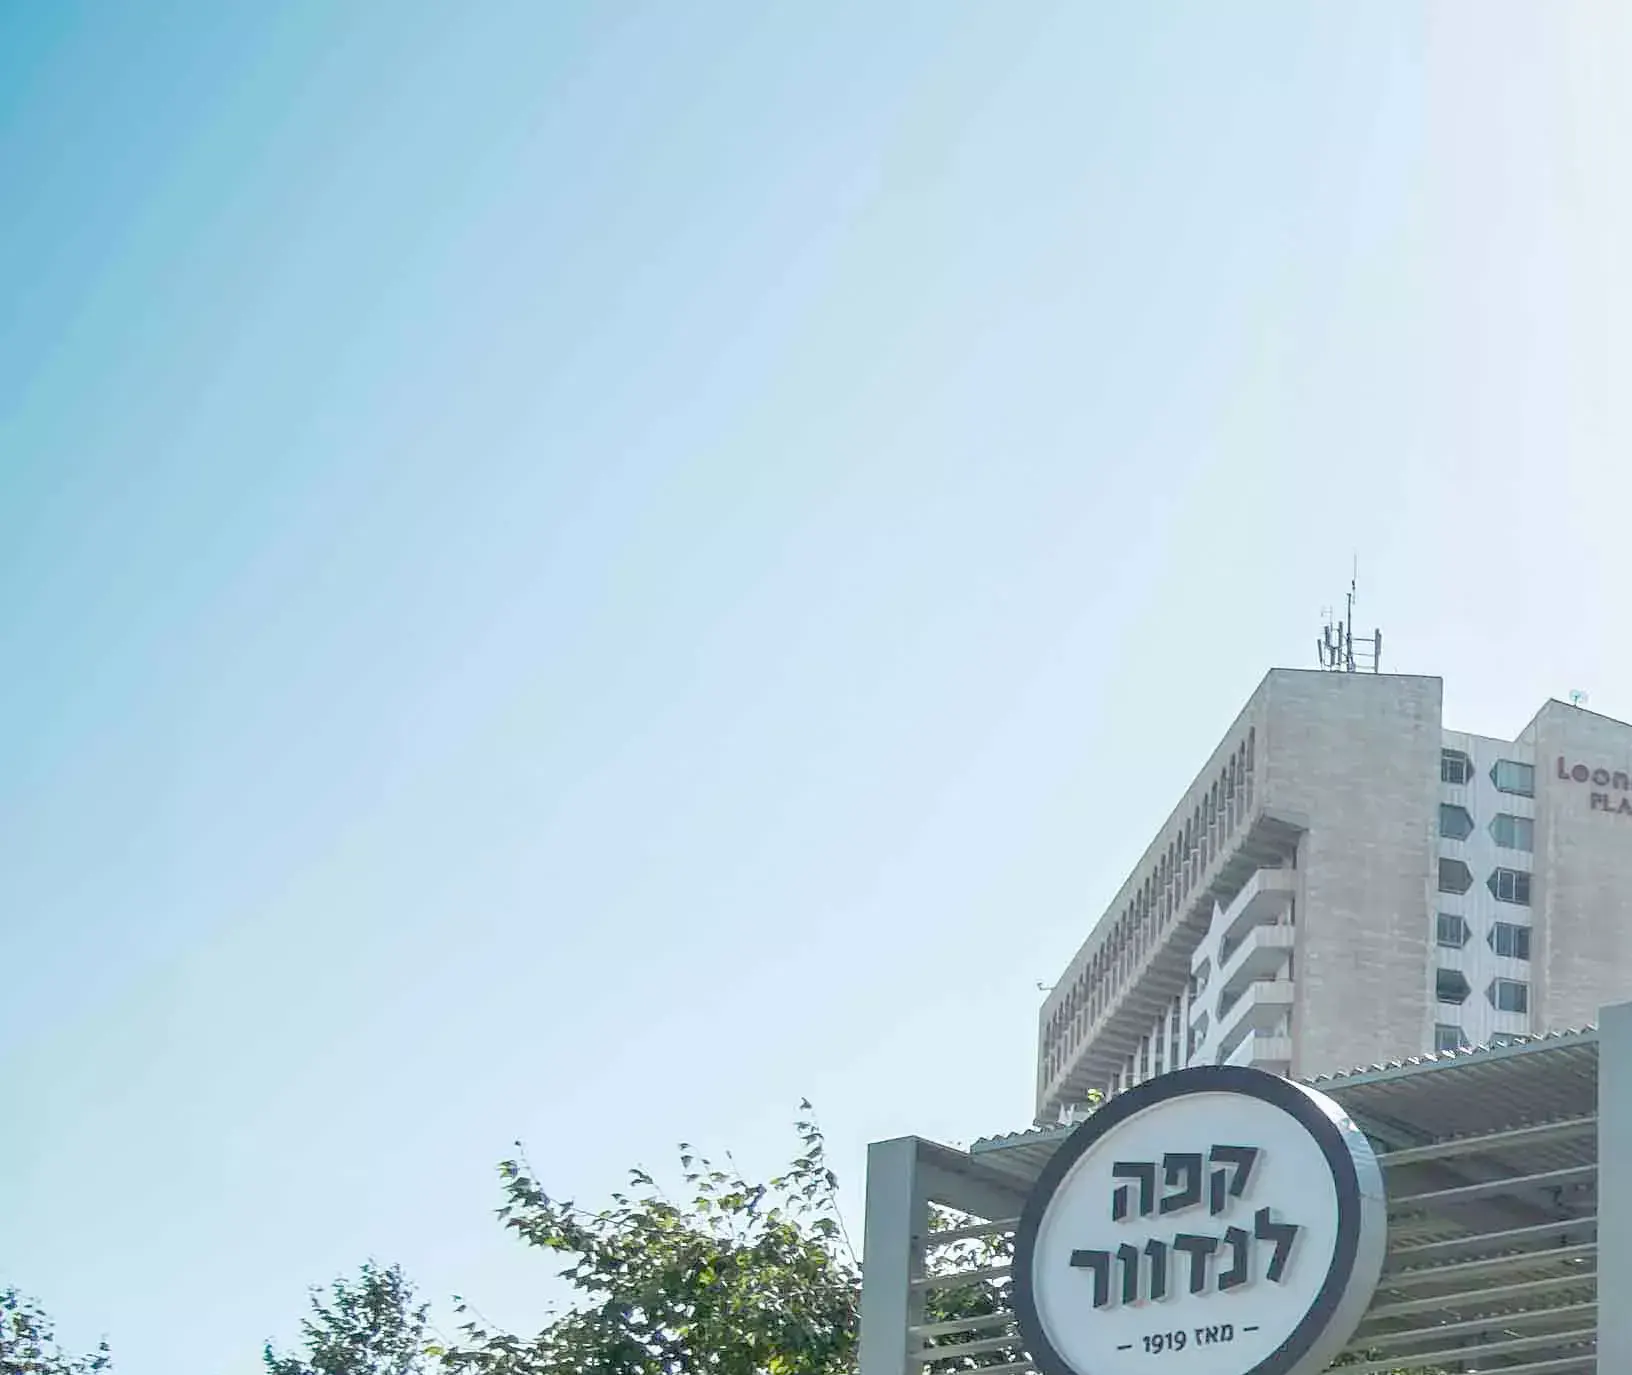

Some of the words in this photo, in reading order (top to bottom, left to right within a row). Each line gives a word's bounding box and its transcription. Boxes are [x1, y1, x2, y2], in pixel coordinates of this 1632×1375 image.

[1111, 1144, 1260, 1222] קפה
[1070, 1207, 1301, 1309] לנדוור
[1142, 1330, 1187, 1354] 1919
[1193, 1324, 1235, 1346] מאז
